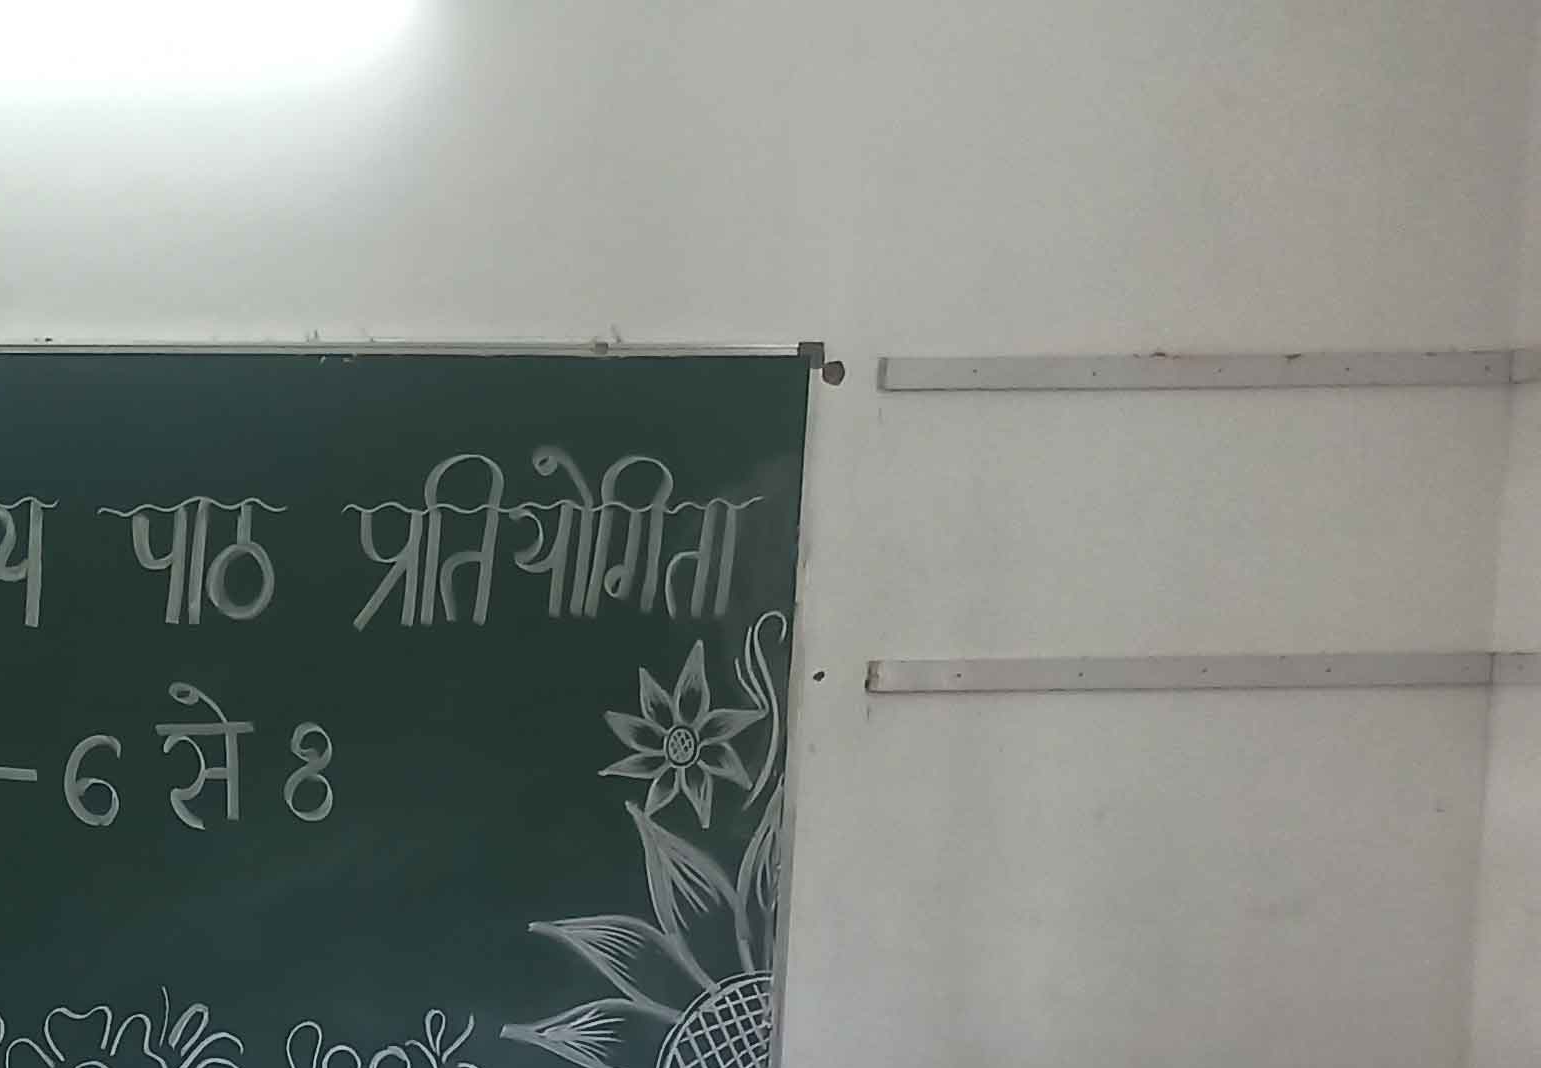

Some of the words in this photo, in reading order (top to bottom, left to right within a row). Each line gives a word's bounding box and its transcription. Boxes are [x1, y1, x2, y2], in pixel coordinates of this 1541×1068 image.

[96, 494, 288, 625] पाठ
[341, 444, 764, 632] प्रतियोगिता
[154, 682, 255, 830] से
[284, 722, 334, 822] 8
